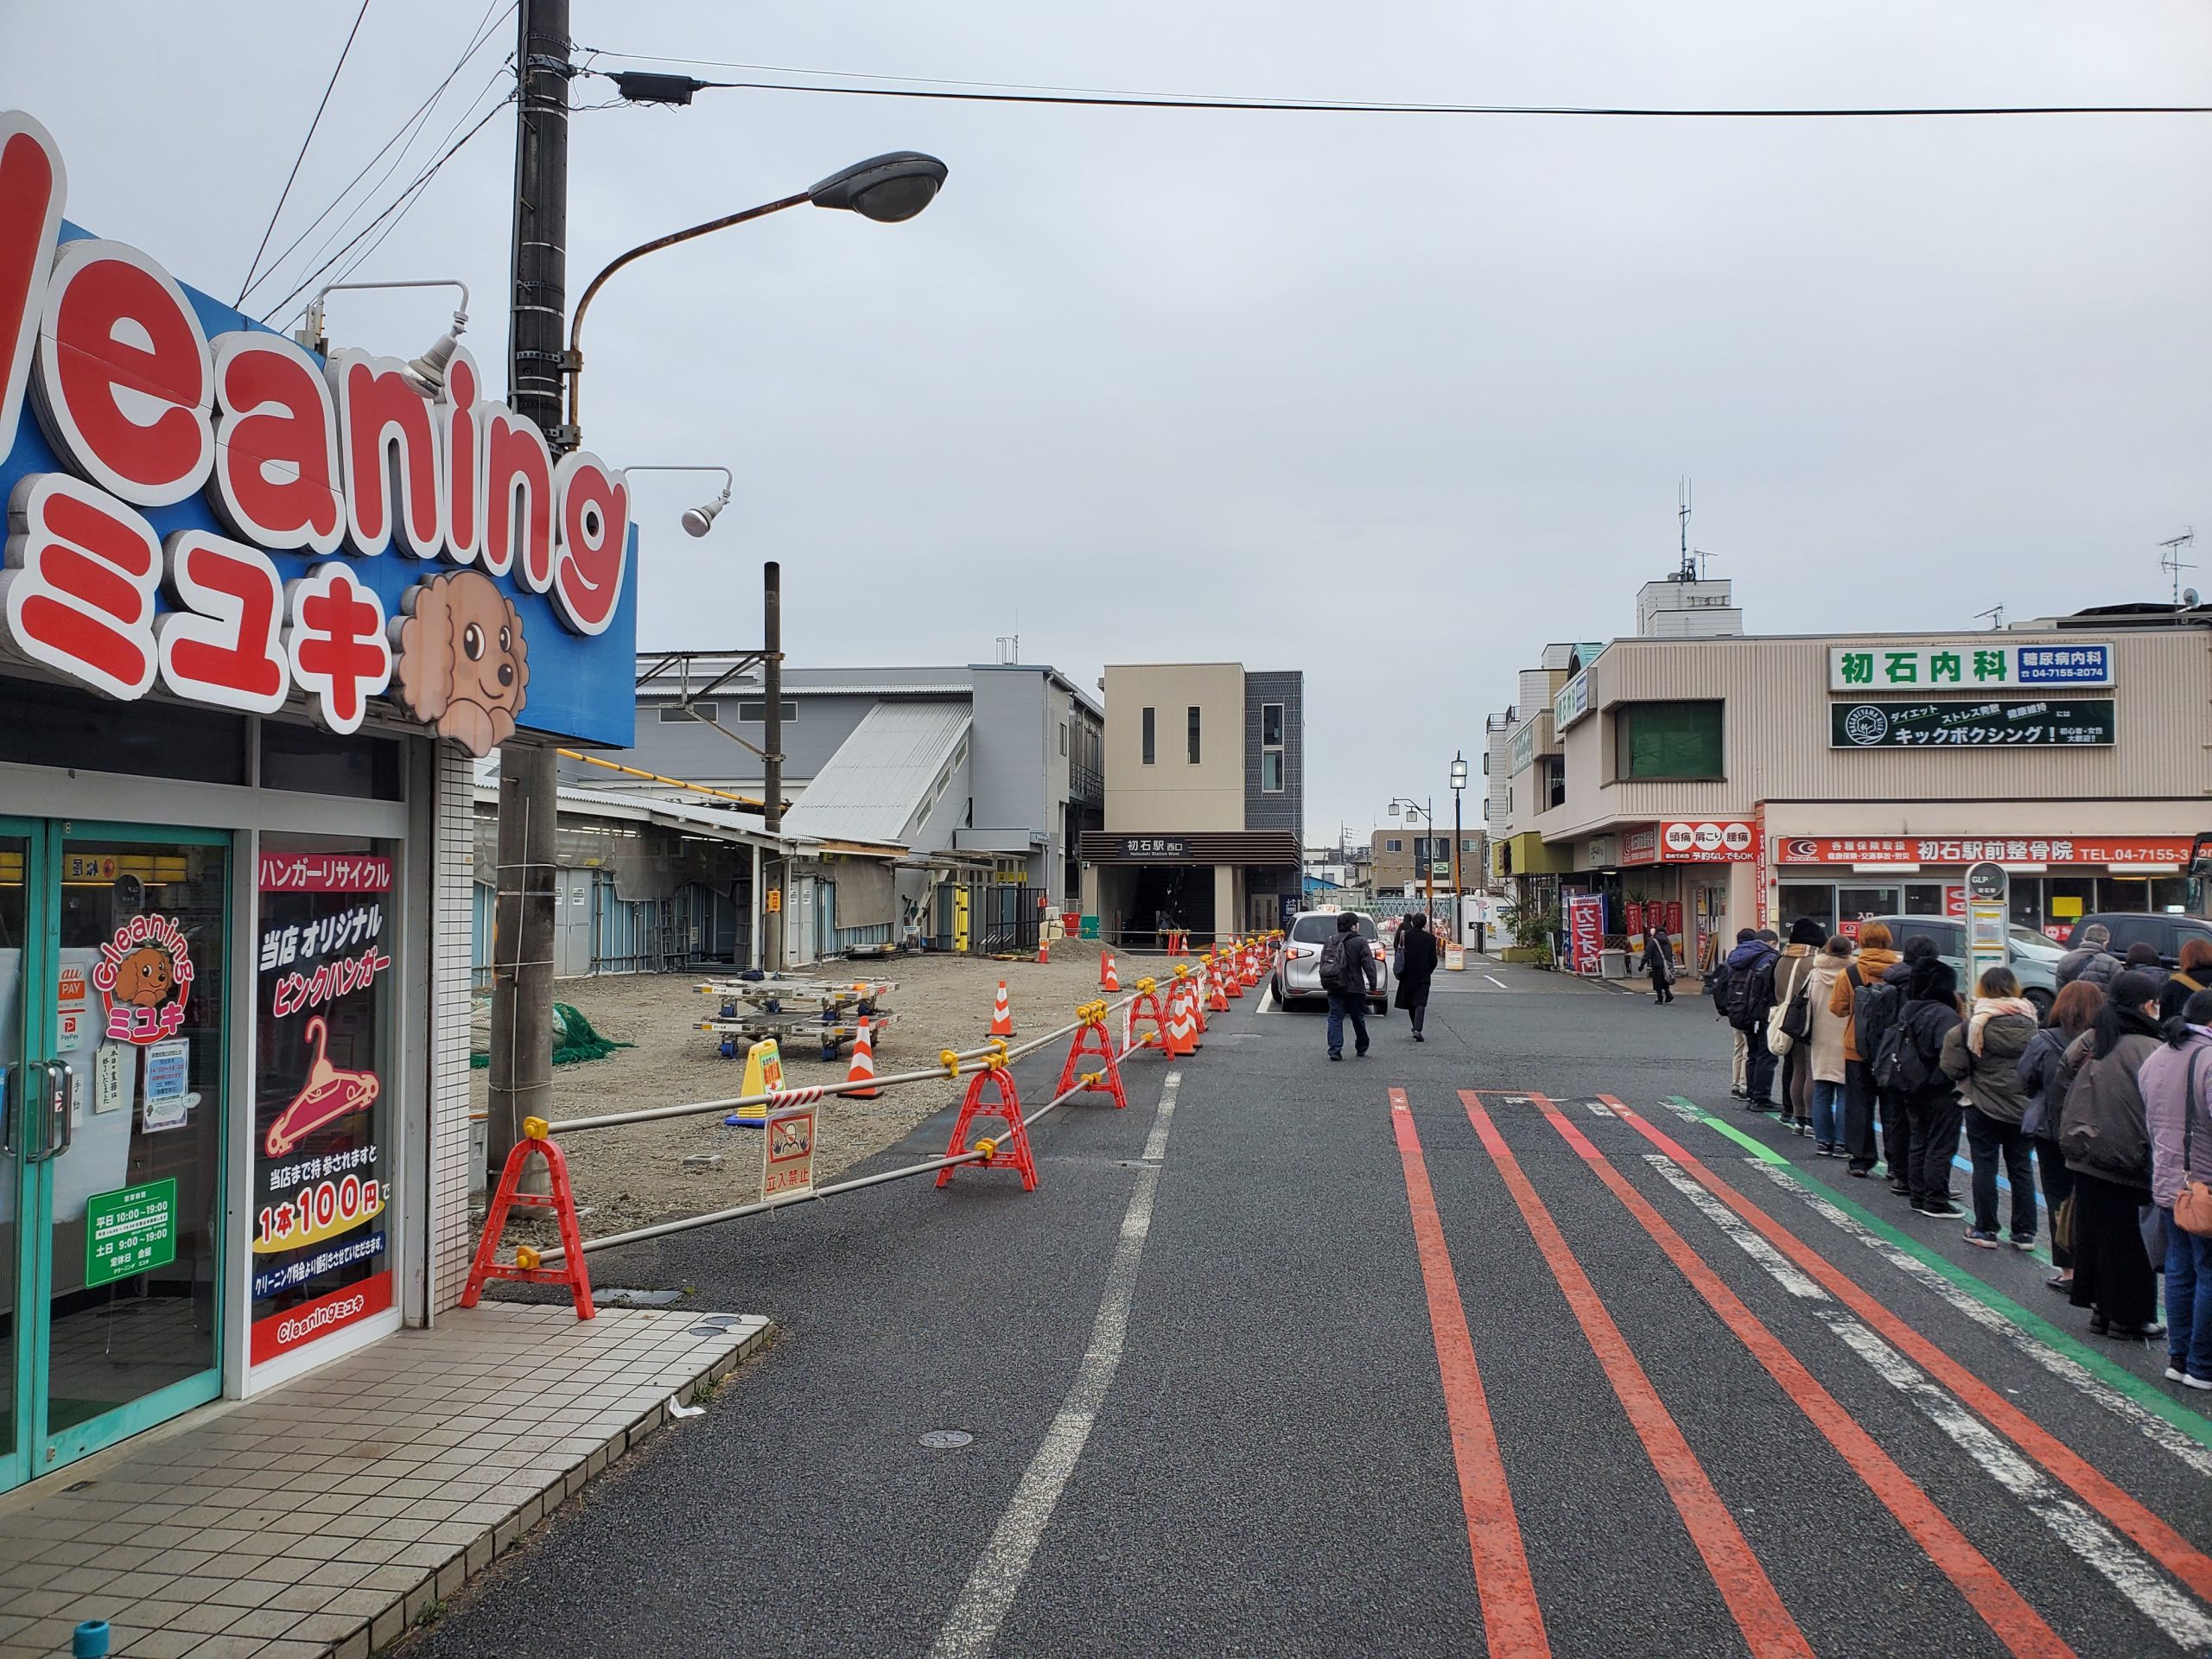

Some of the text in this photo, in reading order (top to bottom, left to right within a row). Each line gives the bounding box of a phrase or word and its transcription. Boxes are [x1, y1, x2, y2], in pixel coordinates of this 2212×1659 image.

[7, 474, 392, 734] ミユキ
[1841, 651, 2007, 683] 初石内科
[2023, 651, 2102, 666] 糖尿病内科
[2032, 668, 2103, 677] 04-7155-2074
[1891, 704, 1938, 722] ダイエット
[1941, 703, 2002, 724] ストレス発散
[1127, 840, 1165, 851] 初石駅
[1669, 832, 1748, 842] 頭痛 肩こり 腰痛
[1918, 841, 2074, 861] 初石駅前整骨院
[260, 856, 390, 887] ハンガーリサイクル
[260, 904, 383, 971] 当店 オリジナル
[93, 913, 194, 991] Cleaning
[61, 969, 82, 980] au
[273, 945, 391, 1018] ピンクハンガー
[61, 982, 81, 995] PAY
[106, 1001, 184, 1039] ミユキ
[270, 1145, 378, 1192] 当店まで持参されますと
[766, 1166, 810, 1192] 立入禁止
[96, 1214, 114, 1228] 平日
[96, 1243, 114, 1257] 土日
[110, 1253, 131, 1268] 定休日
